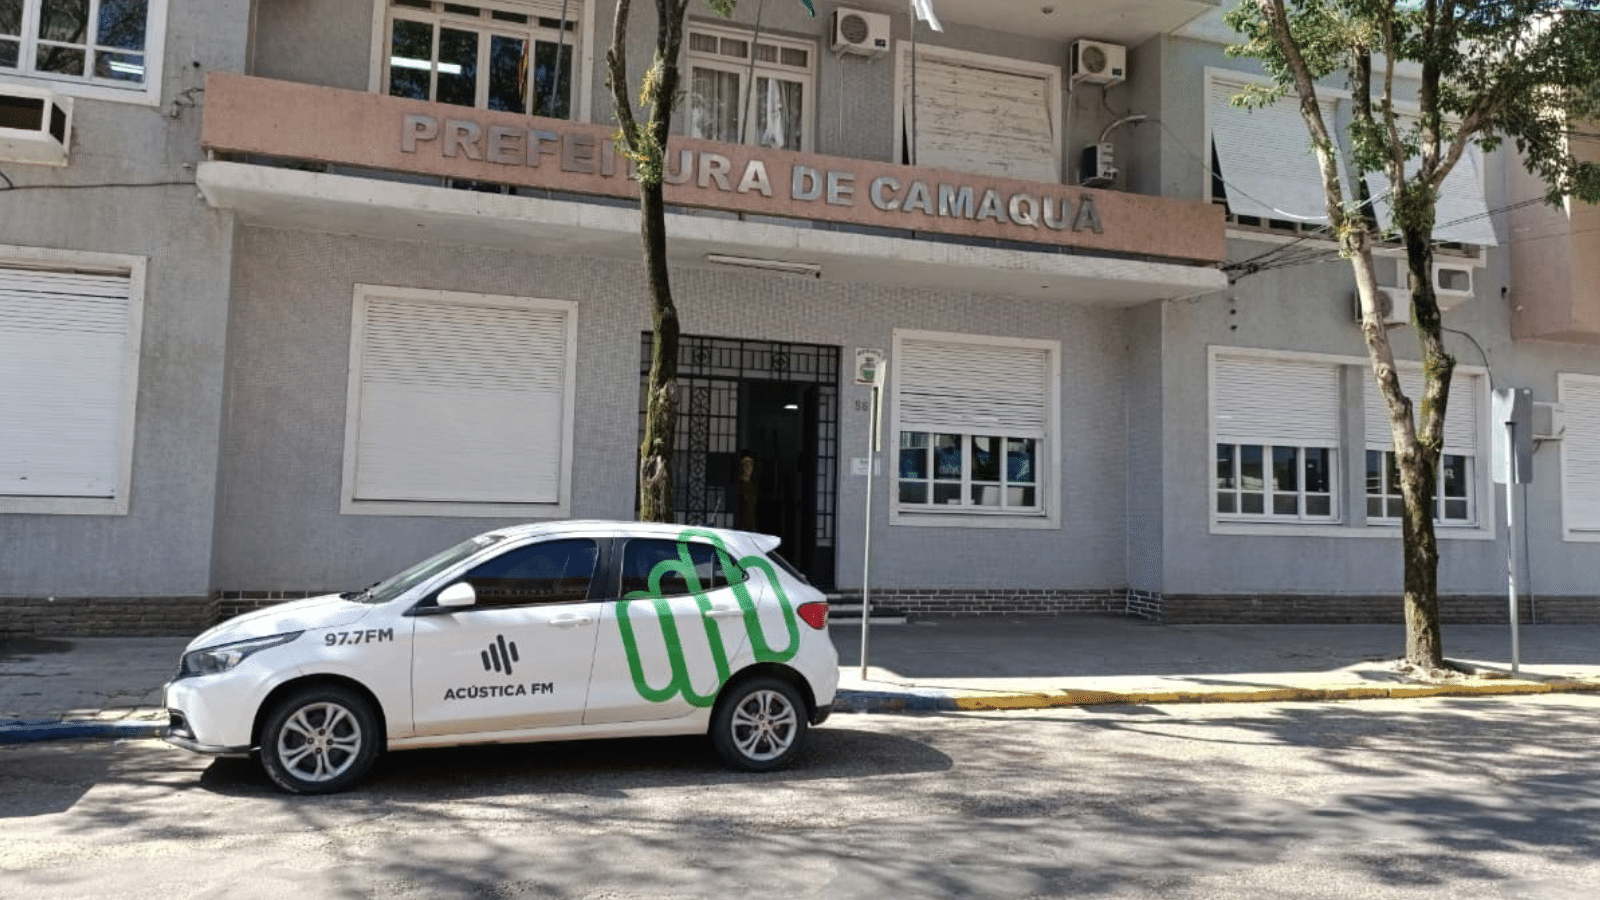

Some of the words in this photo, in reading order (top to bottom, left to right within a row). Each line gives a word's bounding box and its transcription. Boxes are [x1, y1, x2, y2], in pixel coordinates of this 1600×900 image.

[792, 165, 854, 206] DE
[869, 176, 1103, 233] CAMAQUÃ
[325, 628, 394, 646] 97.7FM
[443, 684, 526, 700] ACÚSTICA
[531, 682, 554, 695] FM
